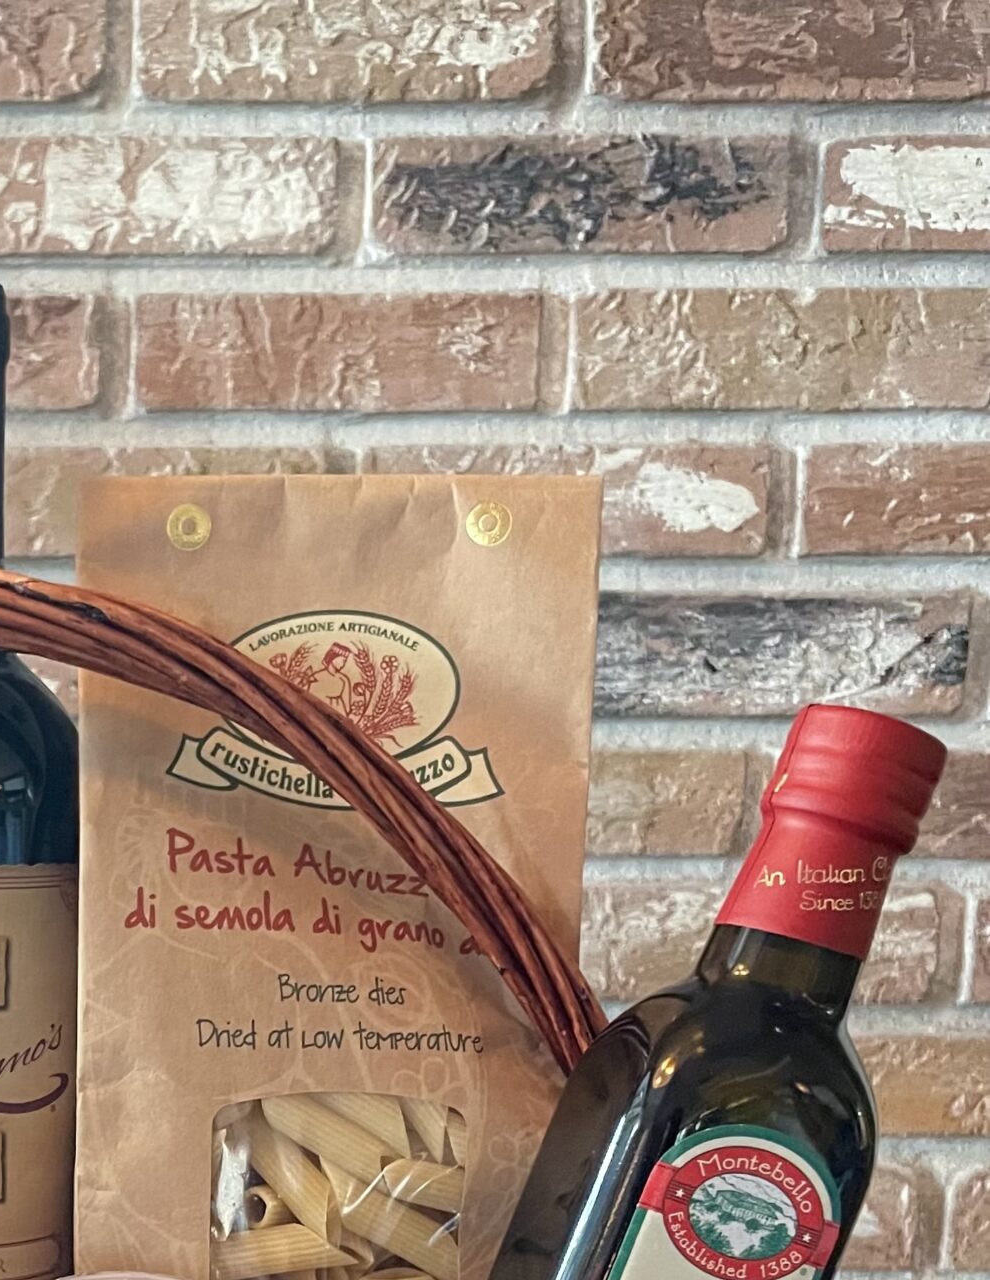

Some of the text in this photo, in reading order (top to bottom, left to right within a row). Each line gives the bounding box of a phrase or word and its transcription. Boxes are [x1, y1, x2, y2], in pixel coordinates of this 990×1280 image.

[248, 621, 421, 652] LAVORAZIONE ARTIGIANALE
[165, 827, 276, 878] Pasta
[754, 865, 786, 888] An
[797, 859, 866, 885] Italian
[799, 890, 855, 911] Since
[124, 886, 157, 930] di
[174, 890, 296, 933] semola
[312, 898, 343, 935] di
[357, 916, 444, 953] grano
[278, 973, 407, 1006] Bronze dies
[196, 1018, 257, 1050] Dried
[267, 1024, 294, 1050] at
[696, 1154, 814, 1214] Montebello
[668, 1210, 804, 1280] Established 1388
